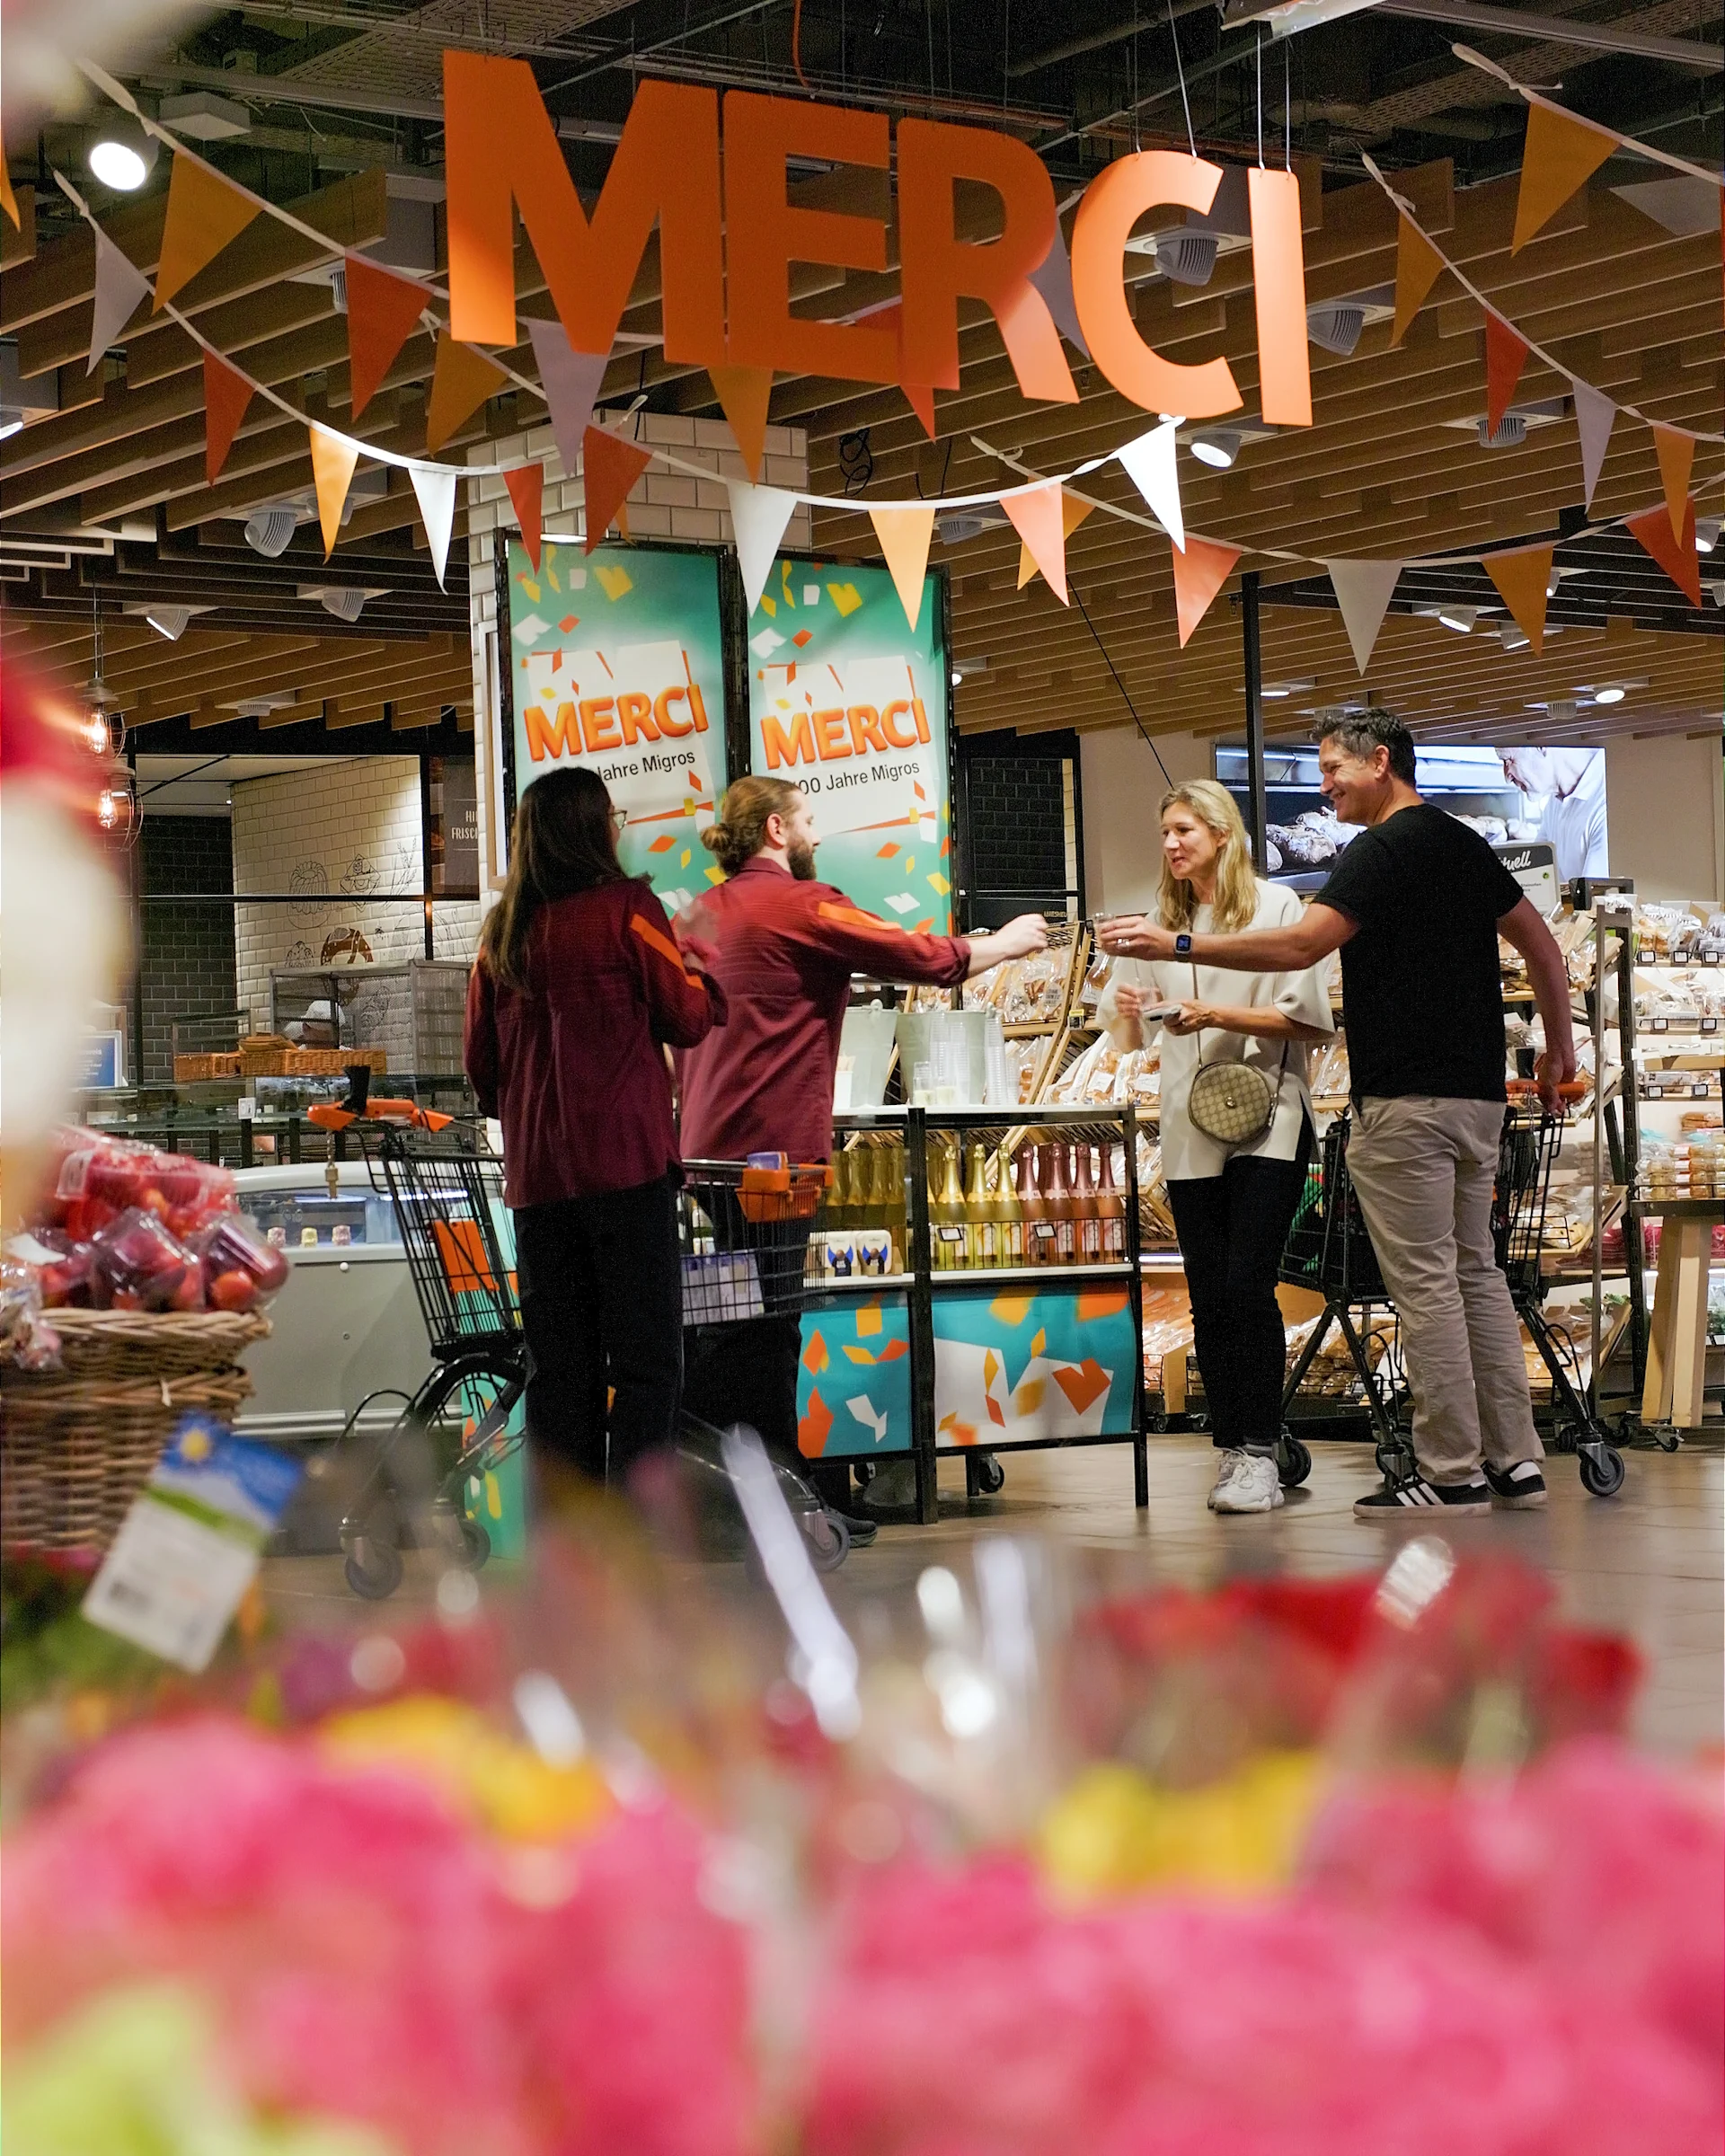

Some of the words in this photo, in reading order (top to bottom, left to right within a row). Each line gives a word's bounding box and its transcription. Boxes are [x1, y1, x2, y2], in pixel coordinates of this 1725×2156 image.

[442, 49, 1313, 426] MERCI
[524, 684, 709, 761] MERCI
[760, 697, 931, 770] MERCI
[641, 751, 695, 773] Migros
[797, 777, 821, 795] 00
[826, 771, 868, 791] Jahre
[871, 762, 920, 782] Migros
[465, 810, 478, 823] HI
